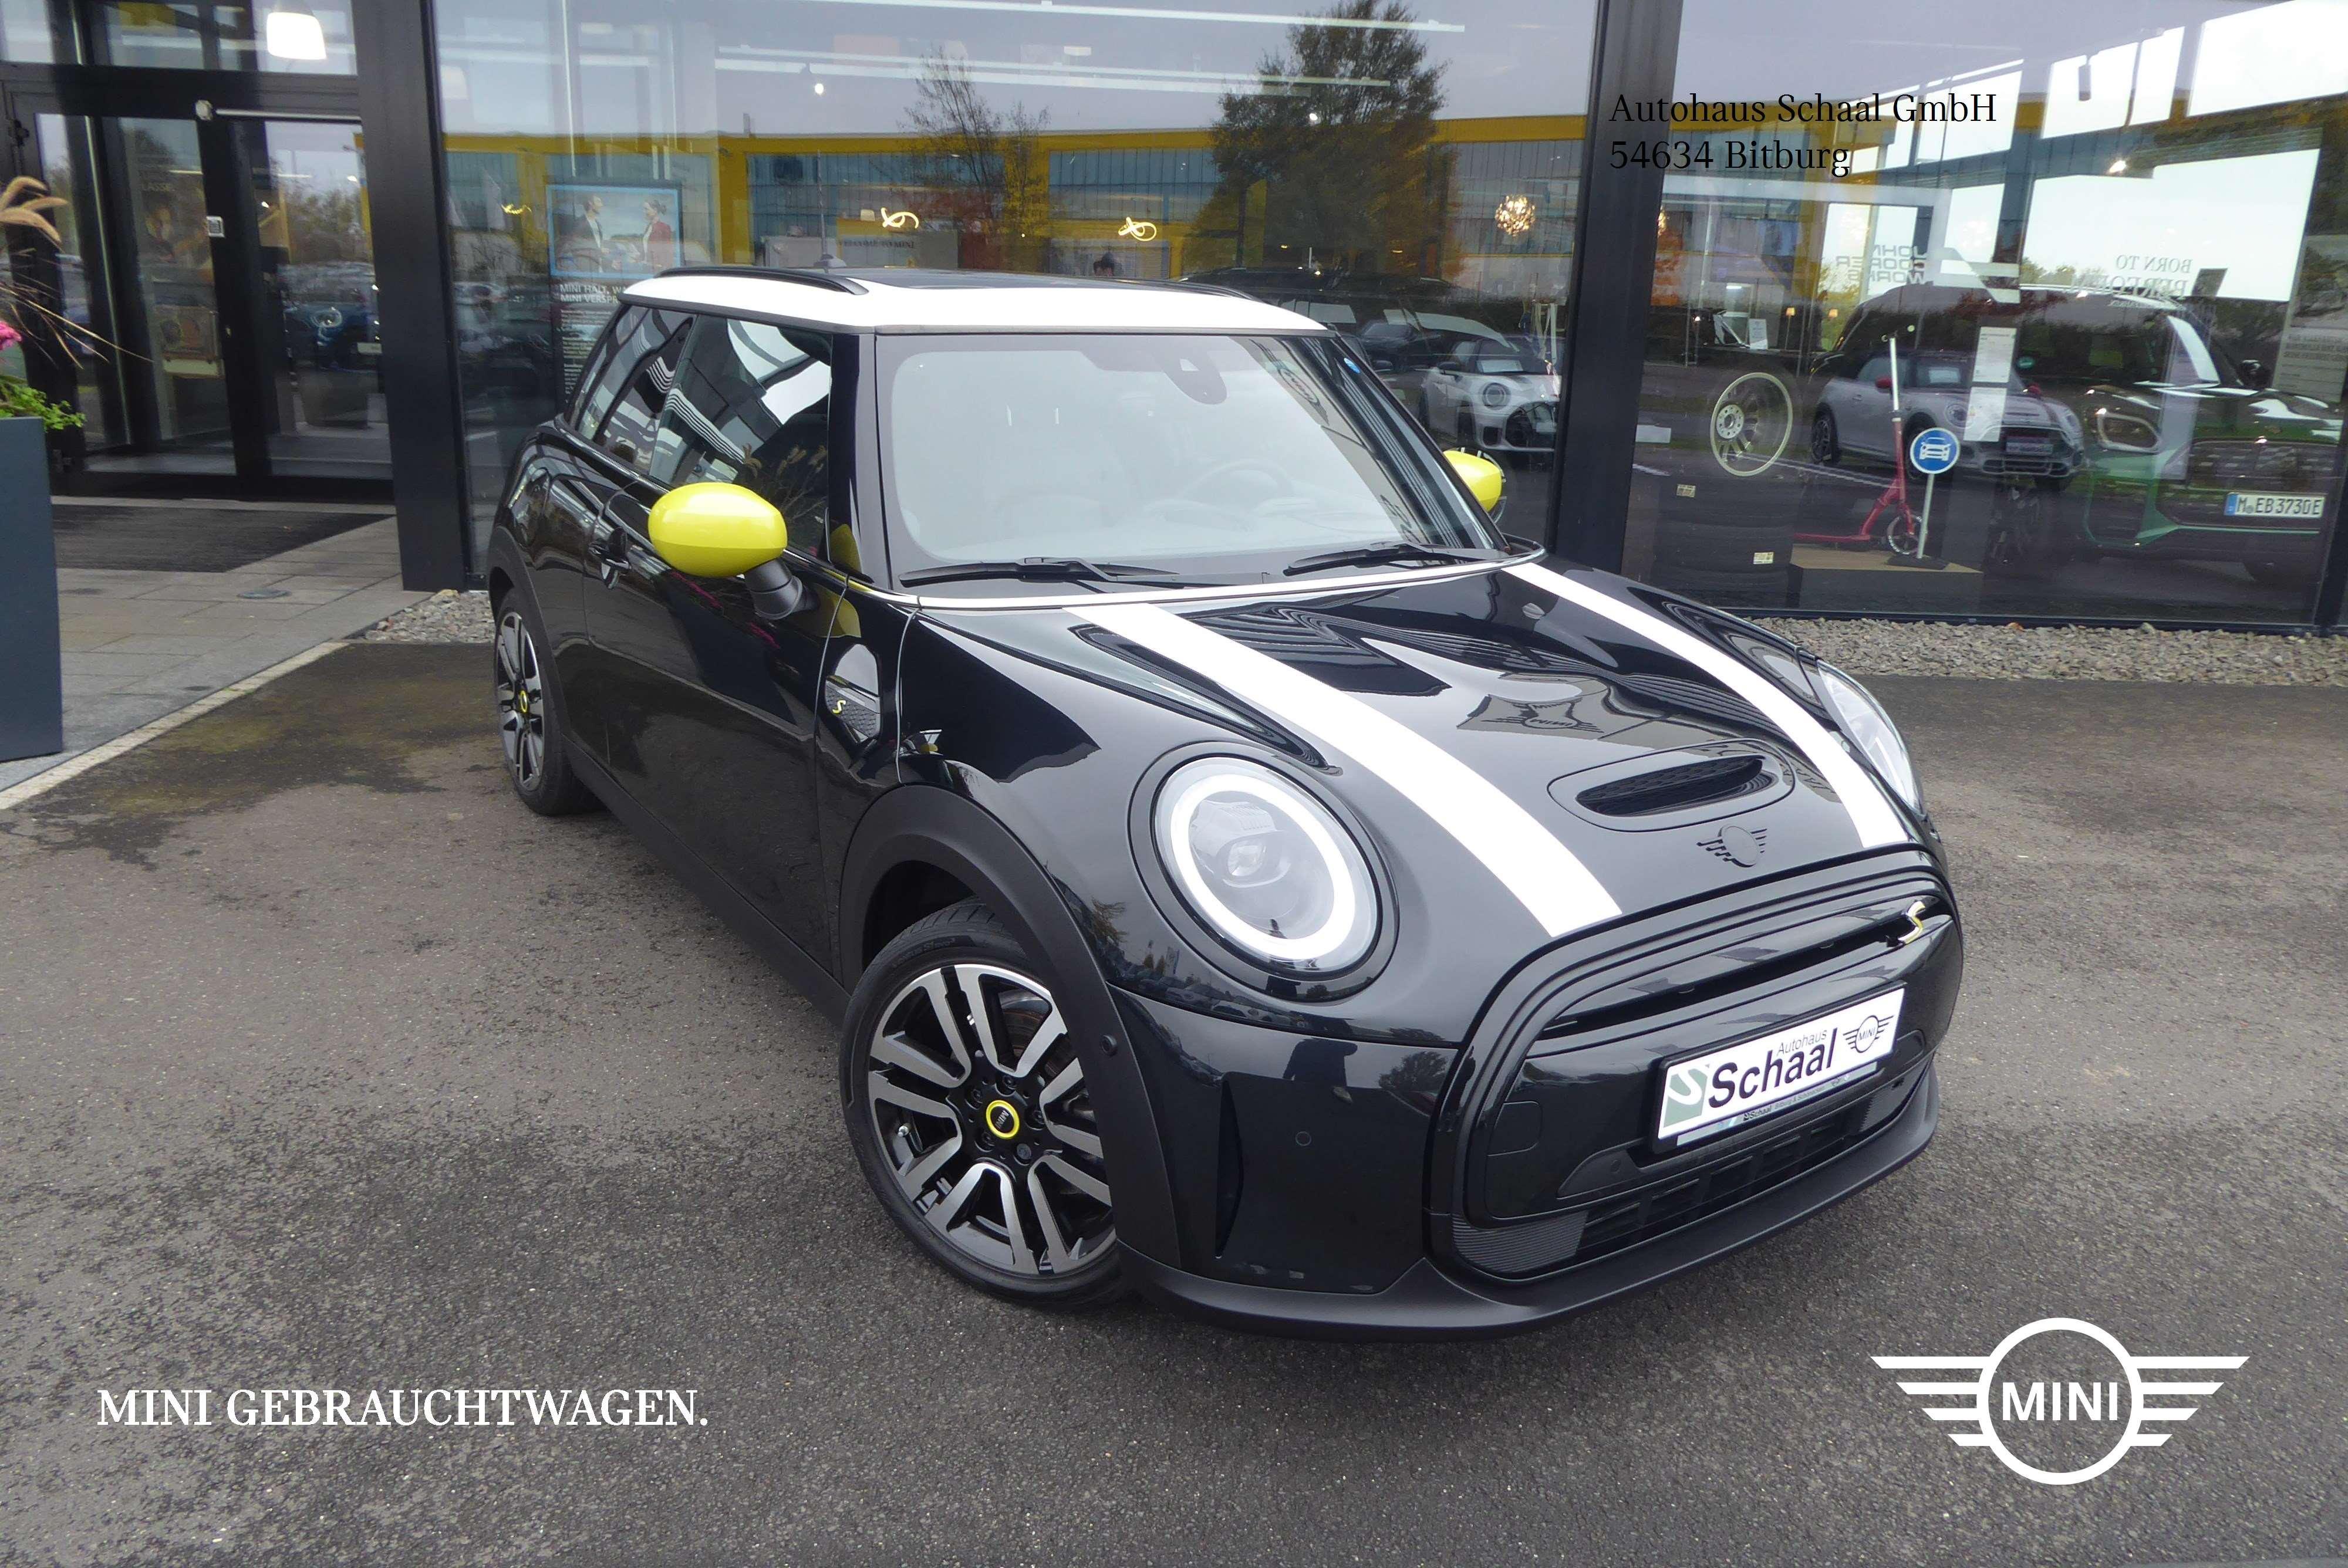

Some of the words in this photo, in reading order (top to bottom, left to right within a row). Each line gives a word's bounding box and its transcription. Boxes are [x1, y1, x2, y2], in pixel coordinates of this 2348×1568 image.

[583, 295, 620, 304] VERSPR
[1777, 1029, 1827, 1056] Autohaus
[1858, 1027, 1876, 1041] MINI
[1709, 1028, 1837, 1108] Schaal
